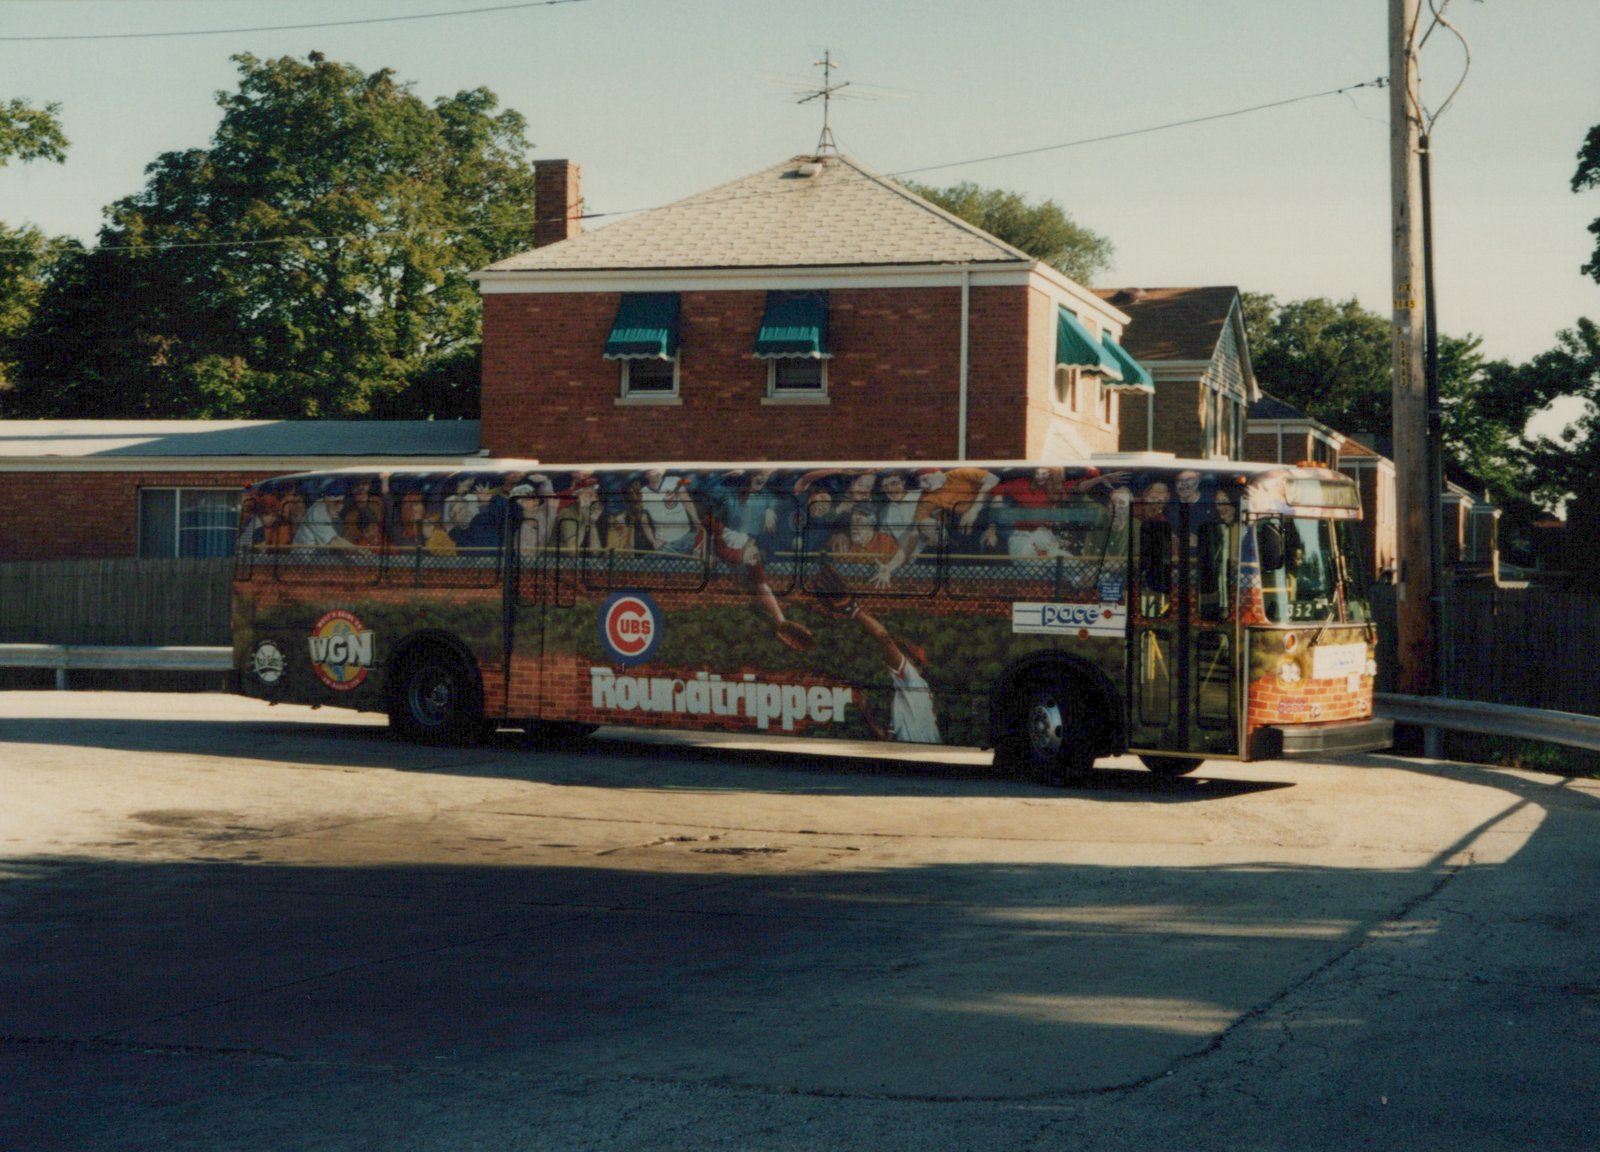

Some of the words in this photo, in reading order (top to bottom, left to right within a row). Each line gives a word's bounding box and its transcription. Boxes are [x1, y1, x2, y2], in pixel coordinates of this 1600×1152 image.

[609, 600, 651, 653] CUBS
[1041, 605, 1099, 626] pace
[308, 631, 374, 668] WGN
[590, 666, 853, 731] Roundtripper
